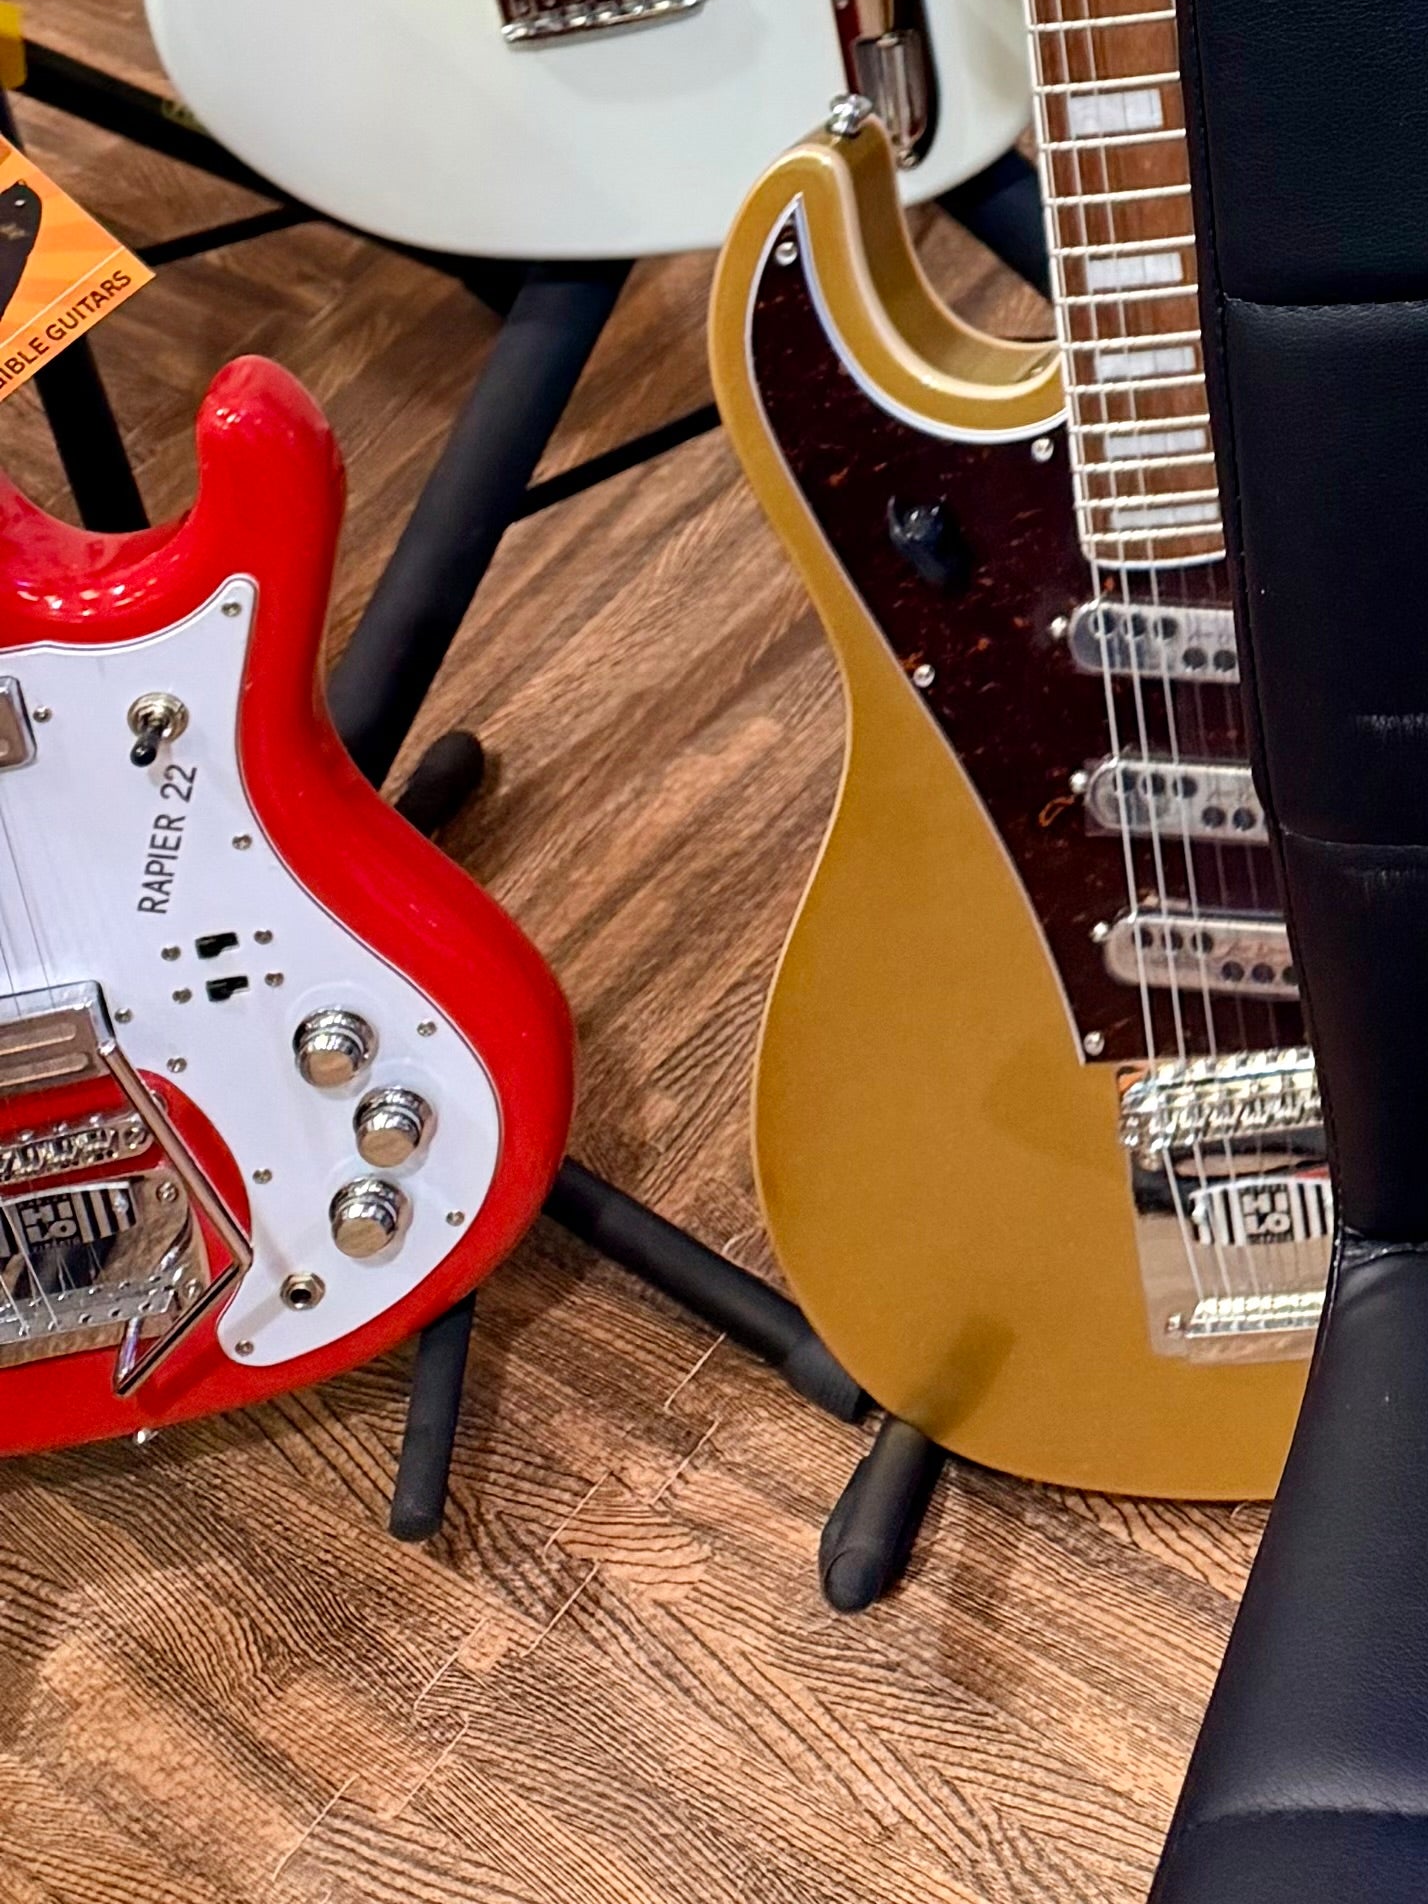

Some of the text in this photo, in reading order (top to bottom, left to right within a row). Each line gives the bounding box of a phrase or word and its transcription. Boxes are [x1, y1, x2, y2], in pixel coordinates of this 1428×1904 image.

[45, 269, 132, 341] GUITARS
[137, 764, 198, 914] RAPIER 22
[21, 1201, 73, 1227] HI
